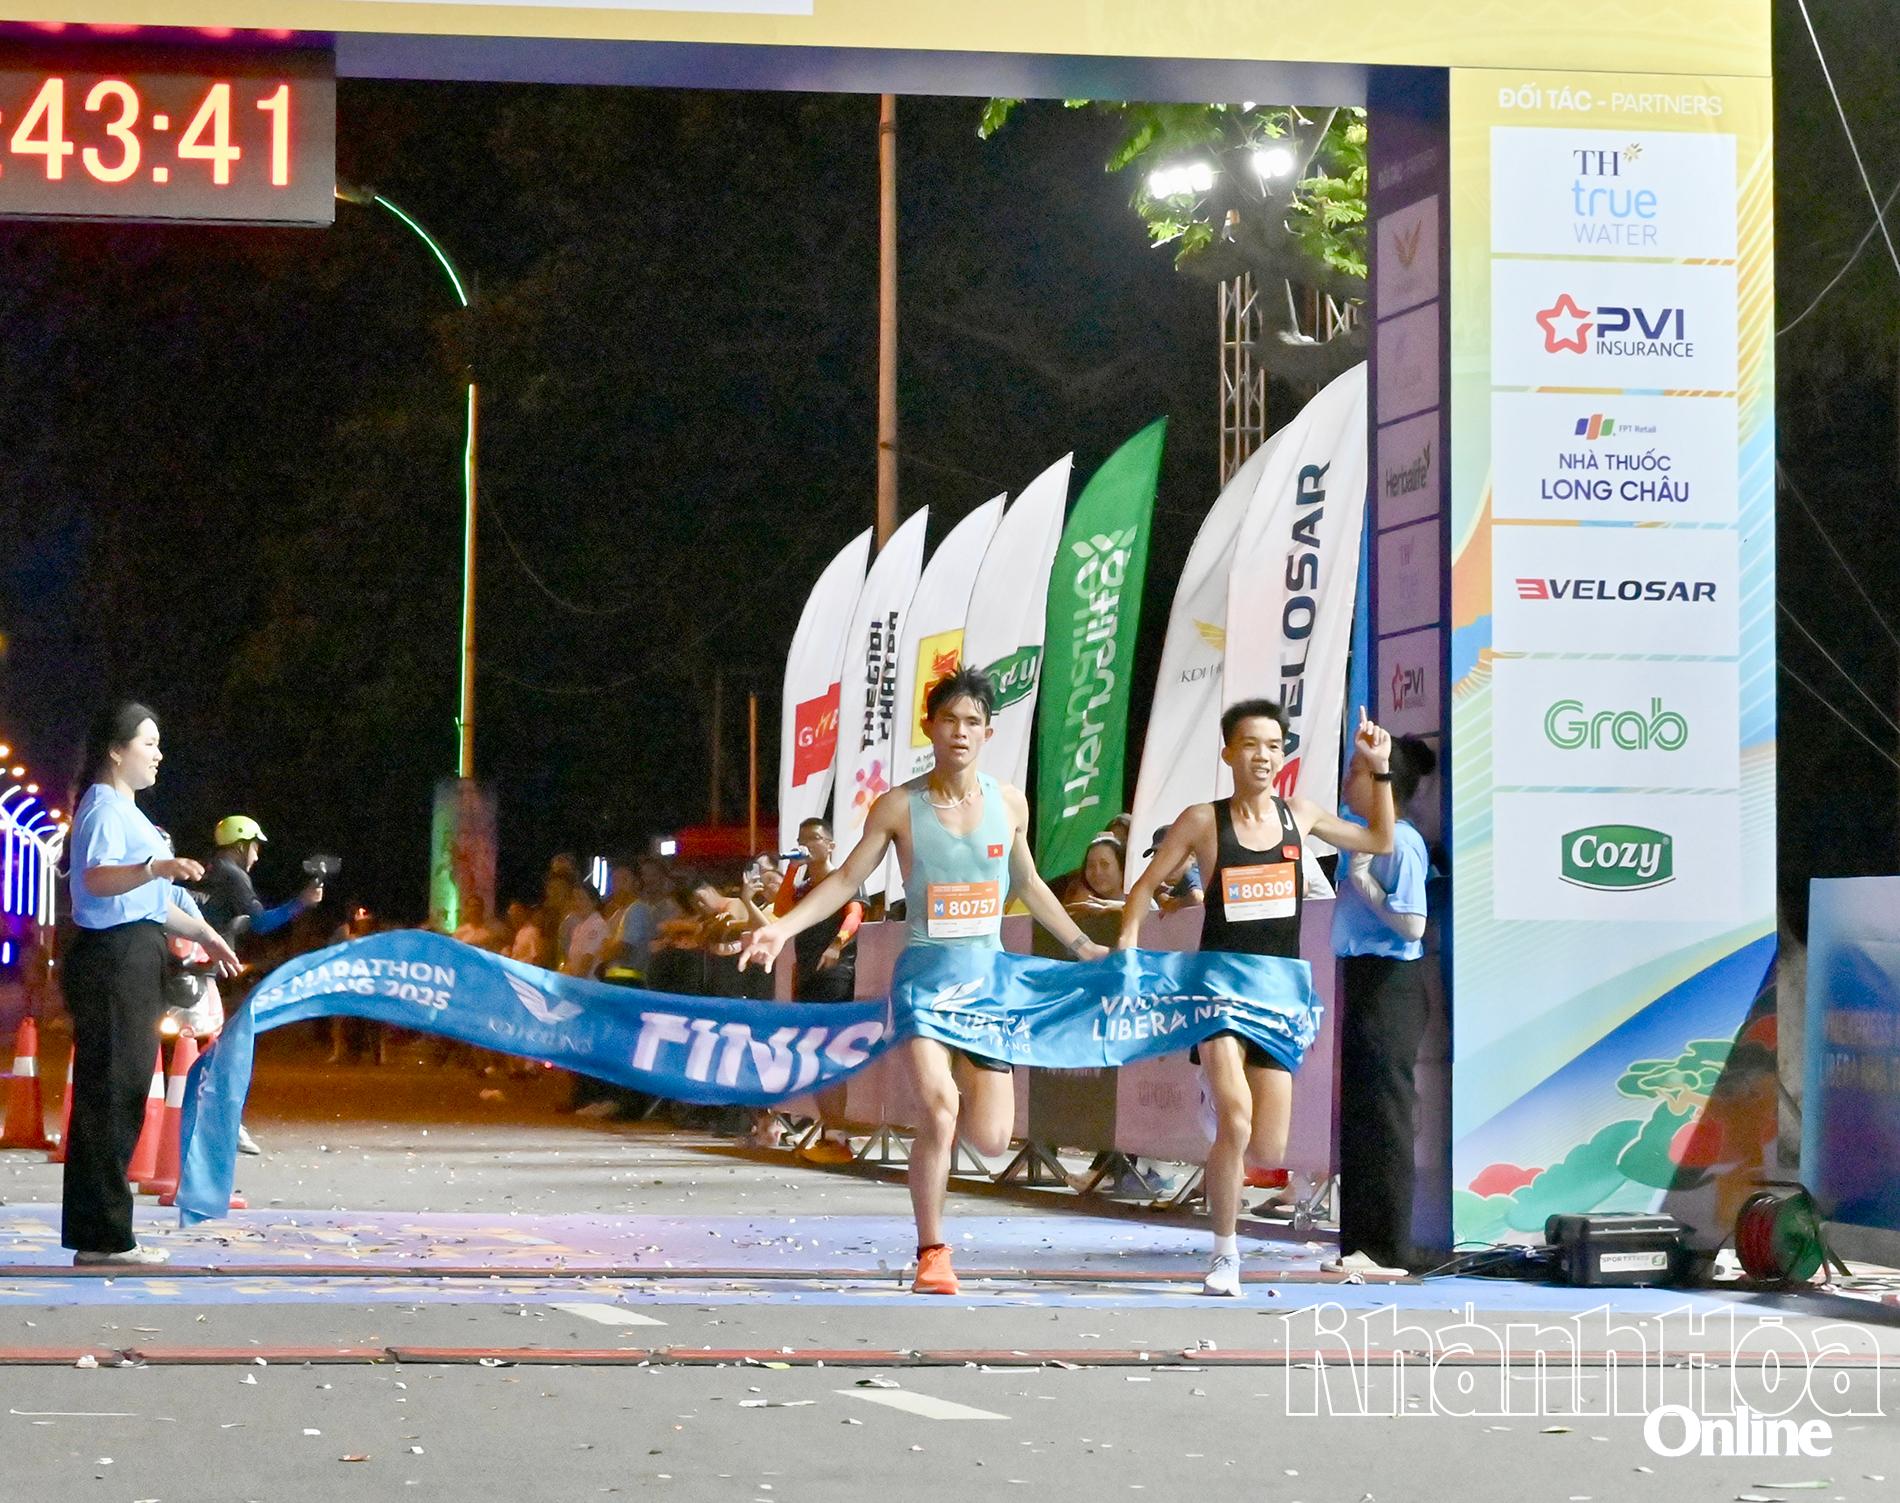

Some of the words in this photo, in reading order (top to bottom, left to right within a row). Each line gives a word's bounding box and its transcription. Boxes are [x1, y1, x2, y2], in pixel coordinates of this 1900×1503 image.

[1498, 83, 1541, 110] ĐỐI
[1547, 86, 1592, 112] TÁC
[1612, 92, 1723, 116] PARTNERS
[0, 78, 289, 186] 43:41
[1573, 150, 1621, 176] TH
[1571, 180, 1657, 218] true
[1574, 224, 1657, 246] WATER
[1597, 307, 1684, 340] PVI
[1596, 342, 1694, 358] INSURANCE
[1618, 424, 1632, 432] FPT
[1559, 449, 1599, 470] NHÀ
[1605, 448, 1671, 471] THUỐC
[1541, 478, 1613, 501] LONG
[1620, 475, 1689, 503] CHÂU
[1549, 579, 1717, 602] VELOSAR
[1181, 666, 1206, 682] KDI
[1404, 666, 1424, 696] PVI
[1544, 697, 1688, 751] Grab
[1569, 834, 1662, 876] Cozy
[1242, 880, 1294, 899] 80309
[949, 898, 997, 916] 80757
[290, 958, 456, 994] MARATHON
[384, 979, 451, 1010] 2025
[1092, 1008, 1188, 1042] LIBERA
[632, 1011, 896, 1094] FINIS
